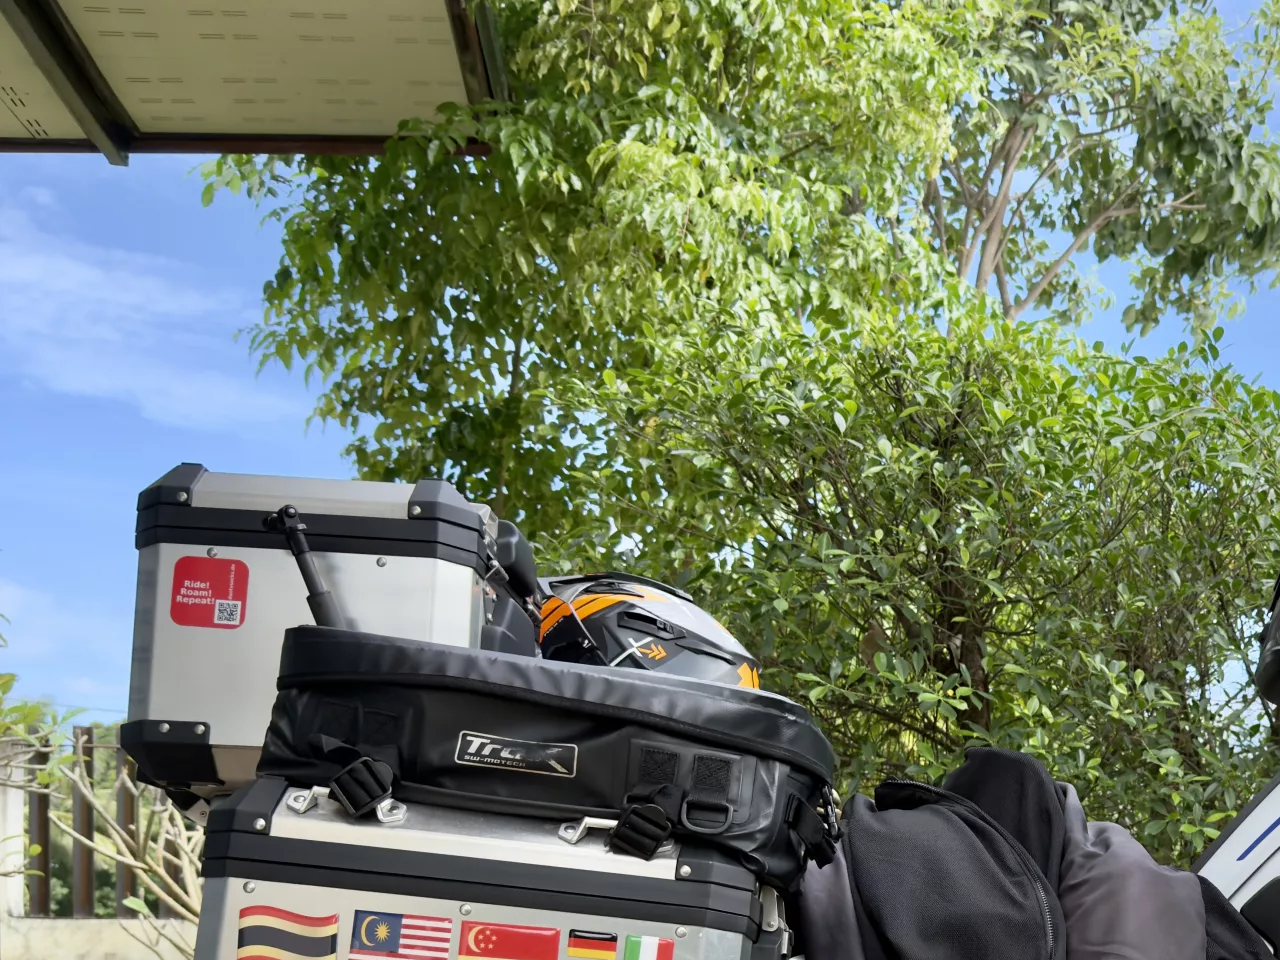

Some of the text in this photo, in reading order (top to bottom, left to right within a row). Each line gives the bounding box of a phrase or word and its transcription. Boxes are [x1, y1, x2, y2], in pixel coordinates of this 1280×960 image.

[184, 580, 210, 589] Ride!
[180, 588, 212, 597] Roam!
[176, 595, 215, 605] Repeat!
